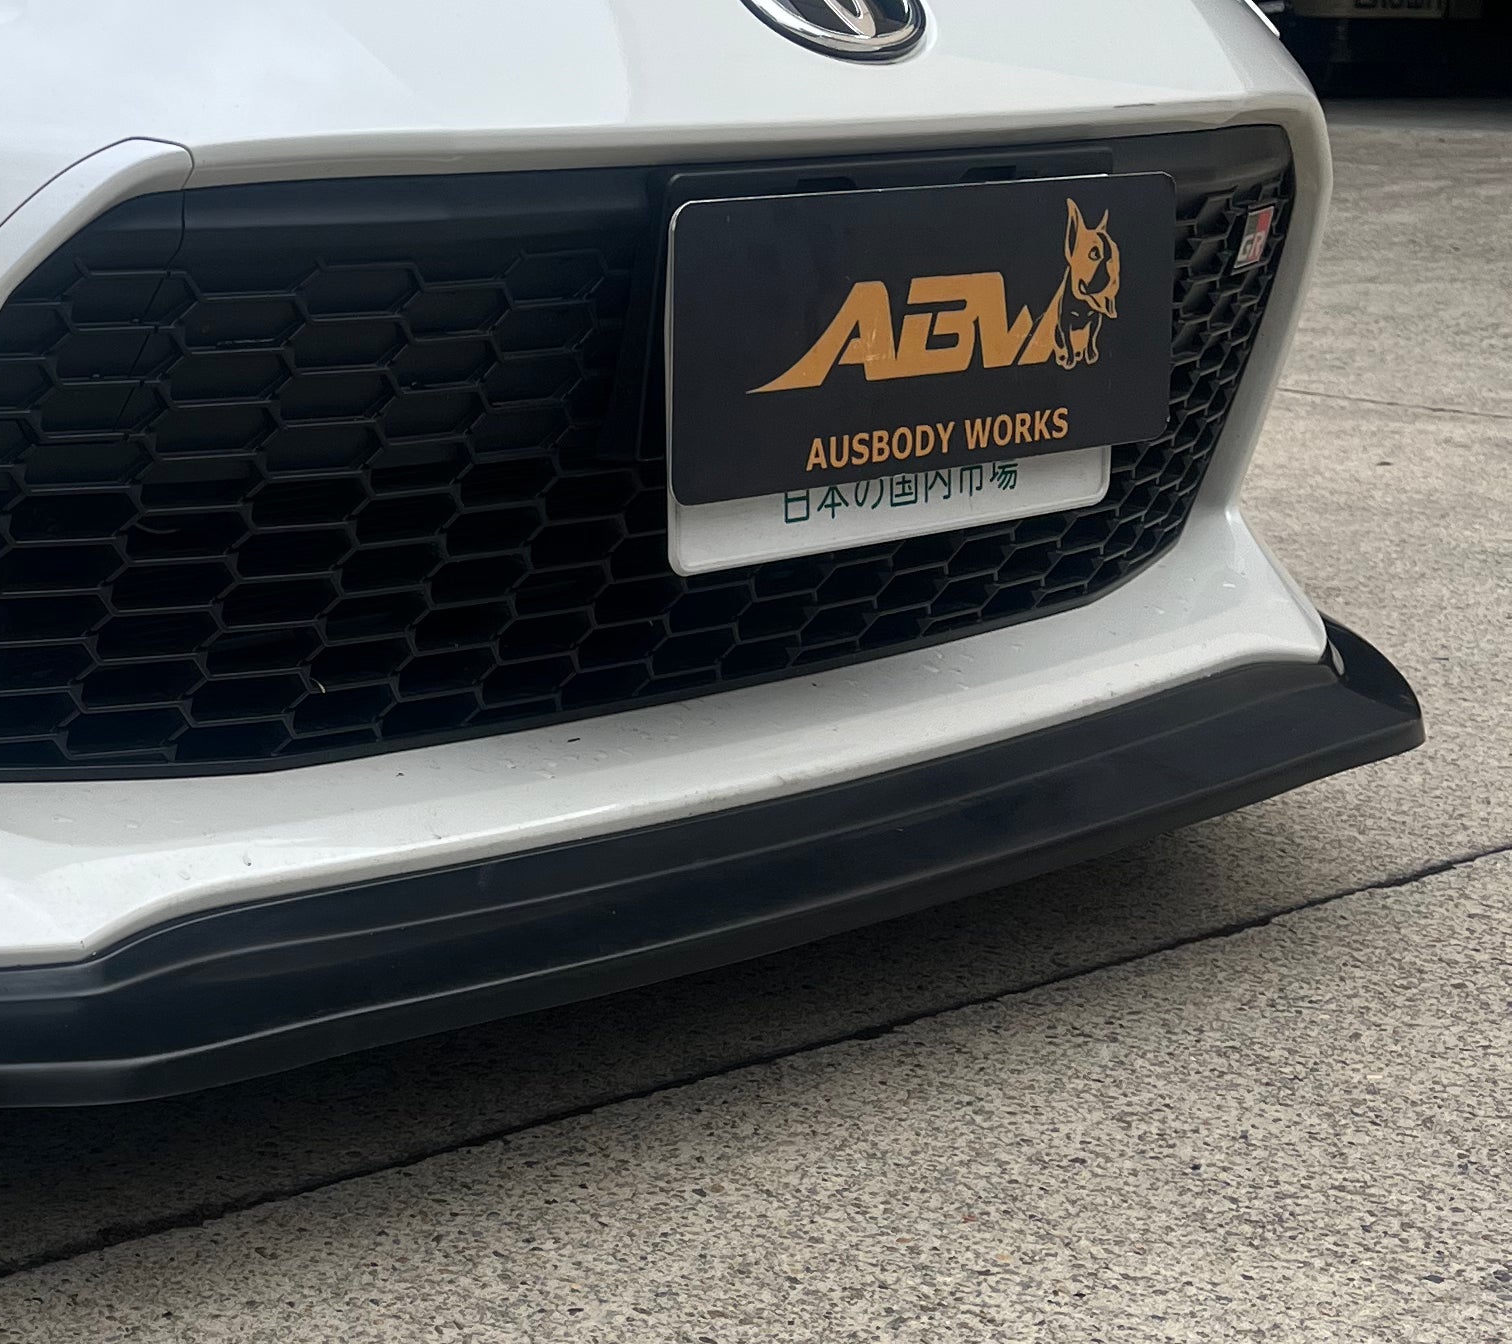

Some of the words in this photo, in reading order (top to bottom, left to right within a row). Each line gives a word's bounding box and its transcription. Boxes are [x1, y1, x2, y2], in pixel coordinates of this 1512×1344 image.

[1237, 230, 1266, 261] GR
[805, 421, 956, 473] AUSBODY
[963, 406, 1070, 451] WORKS
